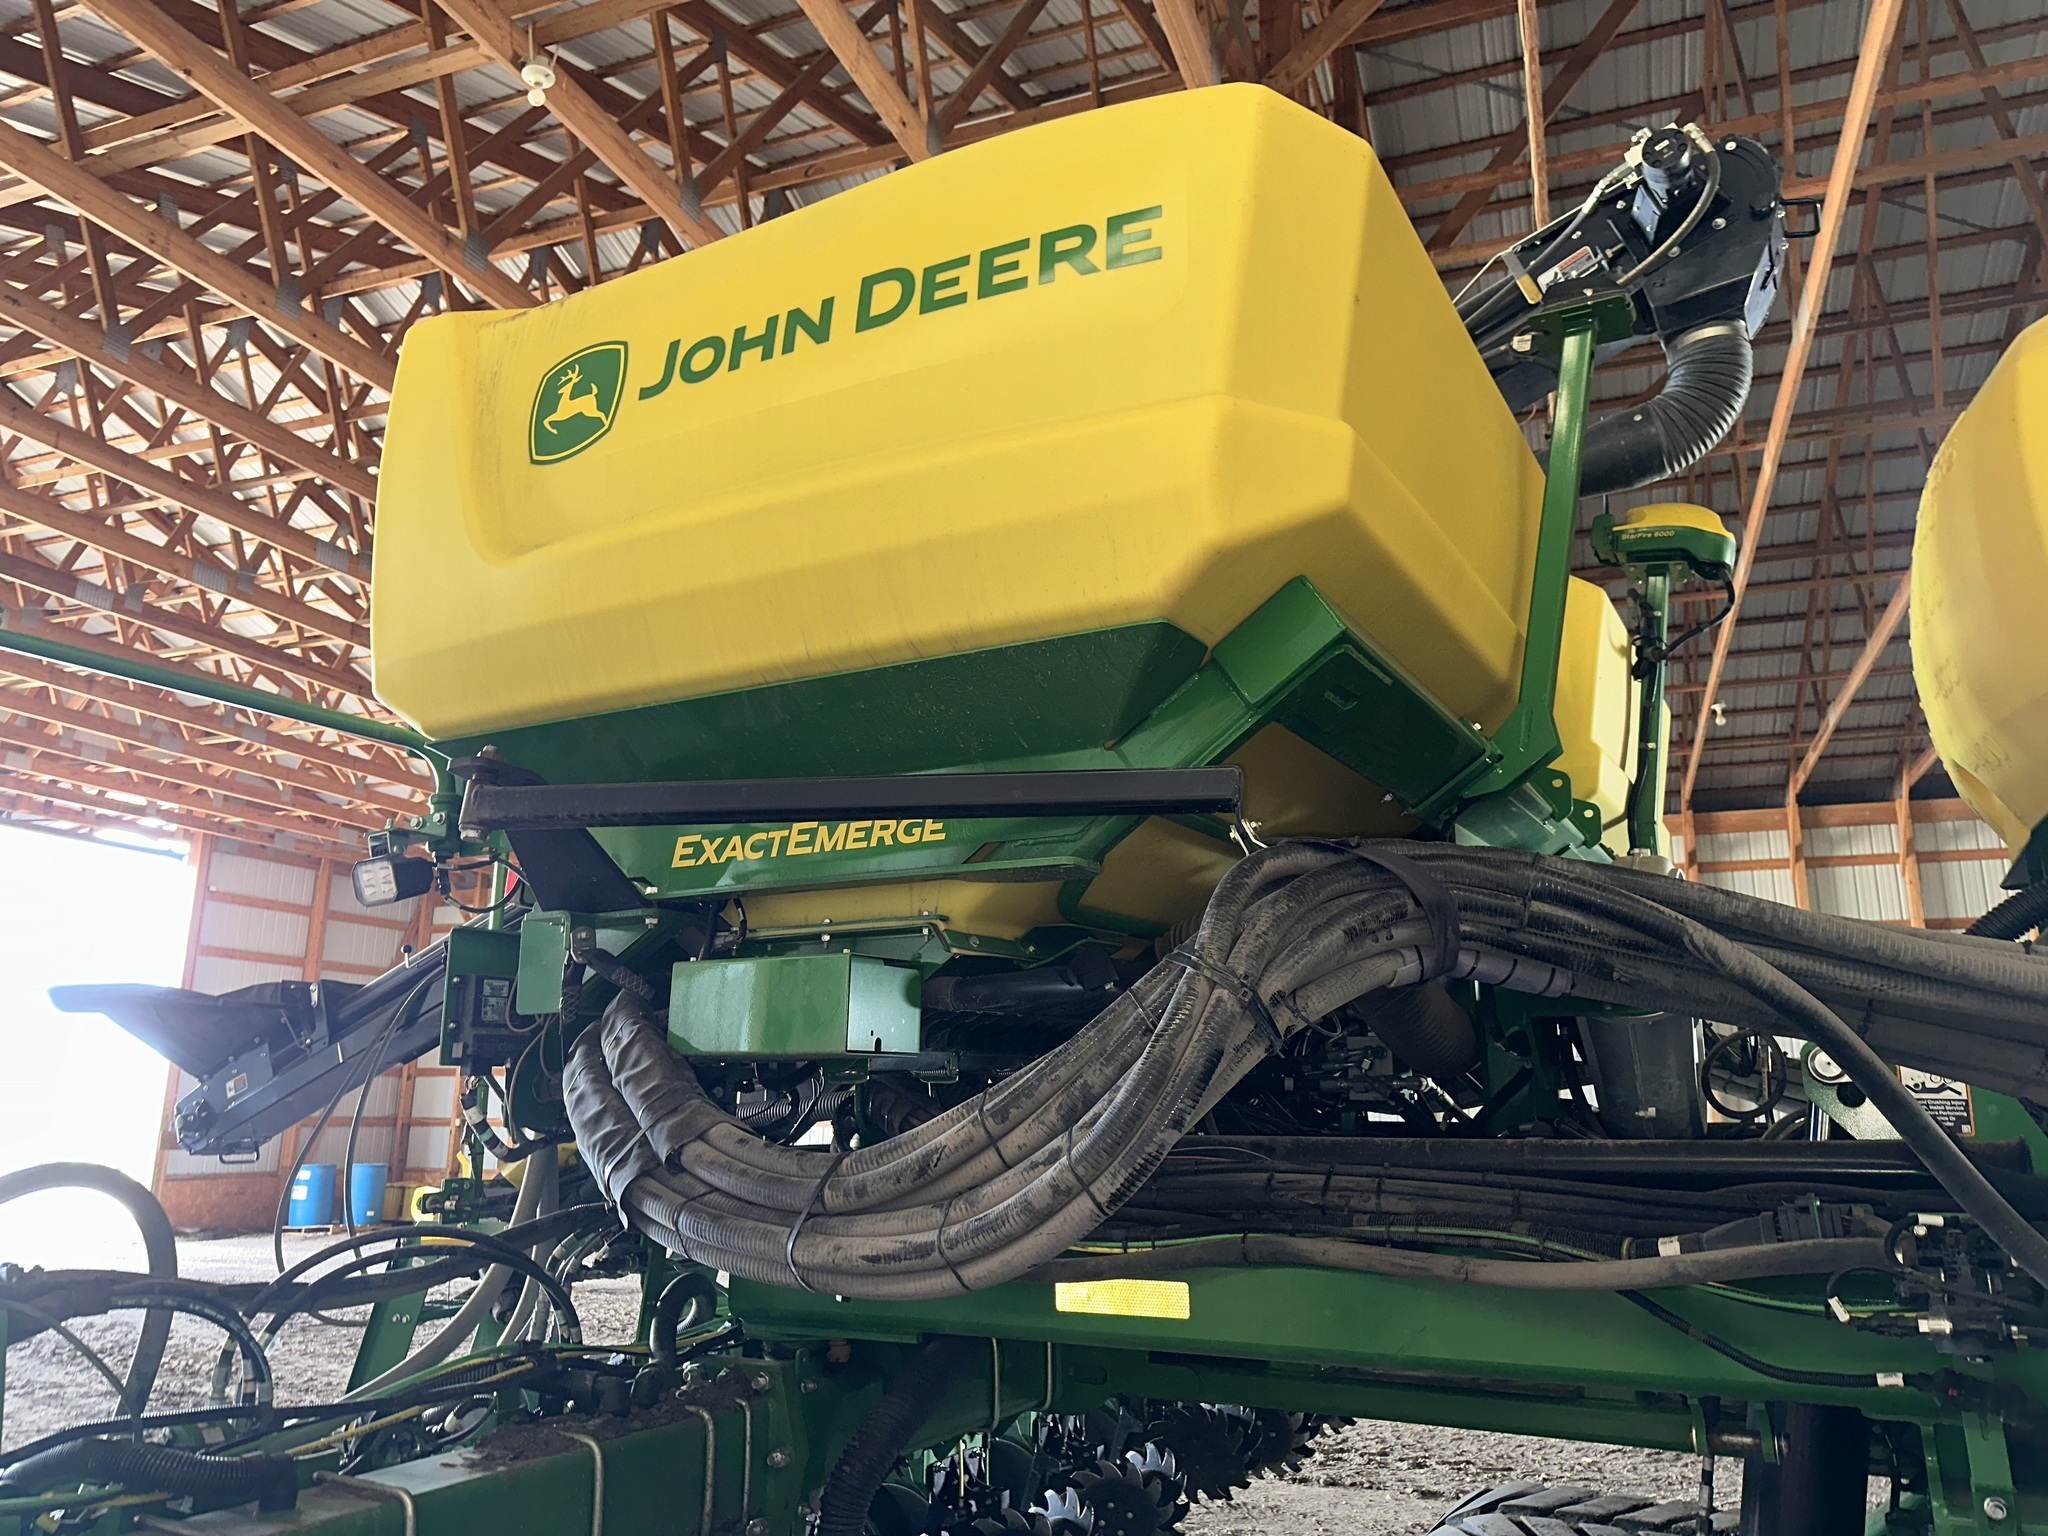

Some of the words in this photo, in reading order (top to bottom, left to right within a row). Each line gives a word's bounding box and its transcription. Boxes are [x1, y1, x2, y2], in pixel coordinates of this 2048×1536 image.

[638, 296, 835, 401] JOHN
[855, 204, 1163, 334] DEERE
[1621, 532, 1652, 540] StarFire
